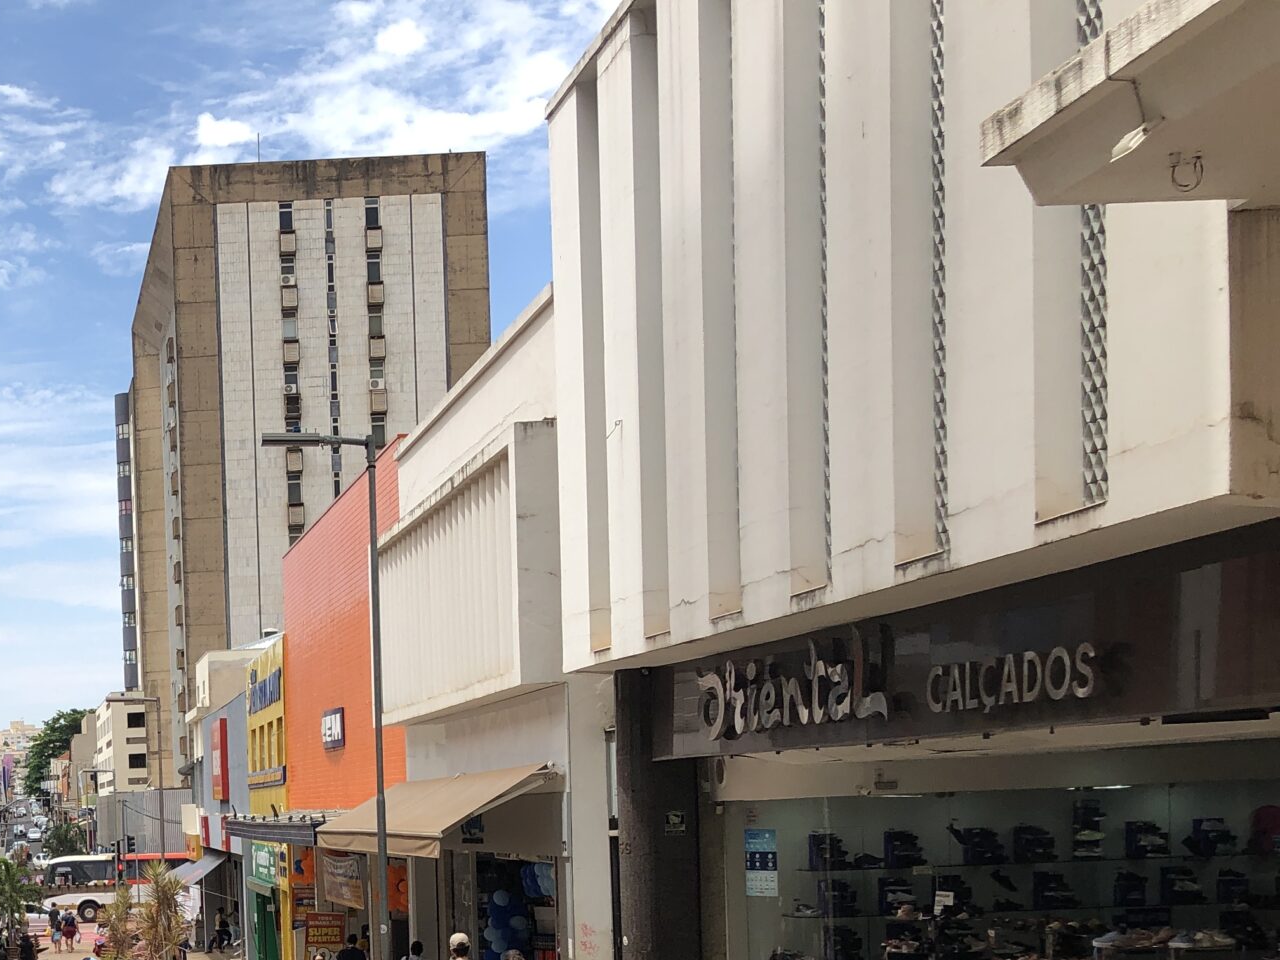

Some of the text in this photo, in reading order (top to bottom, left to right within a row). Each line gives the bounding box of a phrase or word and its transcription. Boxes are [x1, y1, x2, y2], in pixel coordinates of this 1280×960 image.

[697, 624, 1095, 741] Oriental CALÇADOS
[308, 927, 341, 936] SUPER
